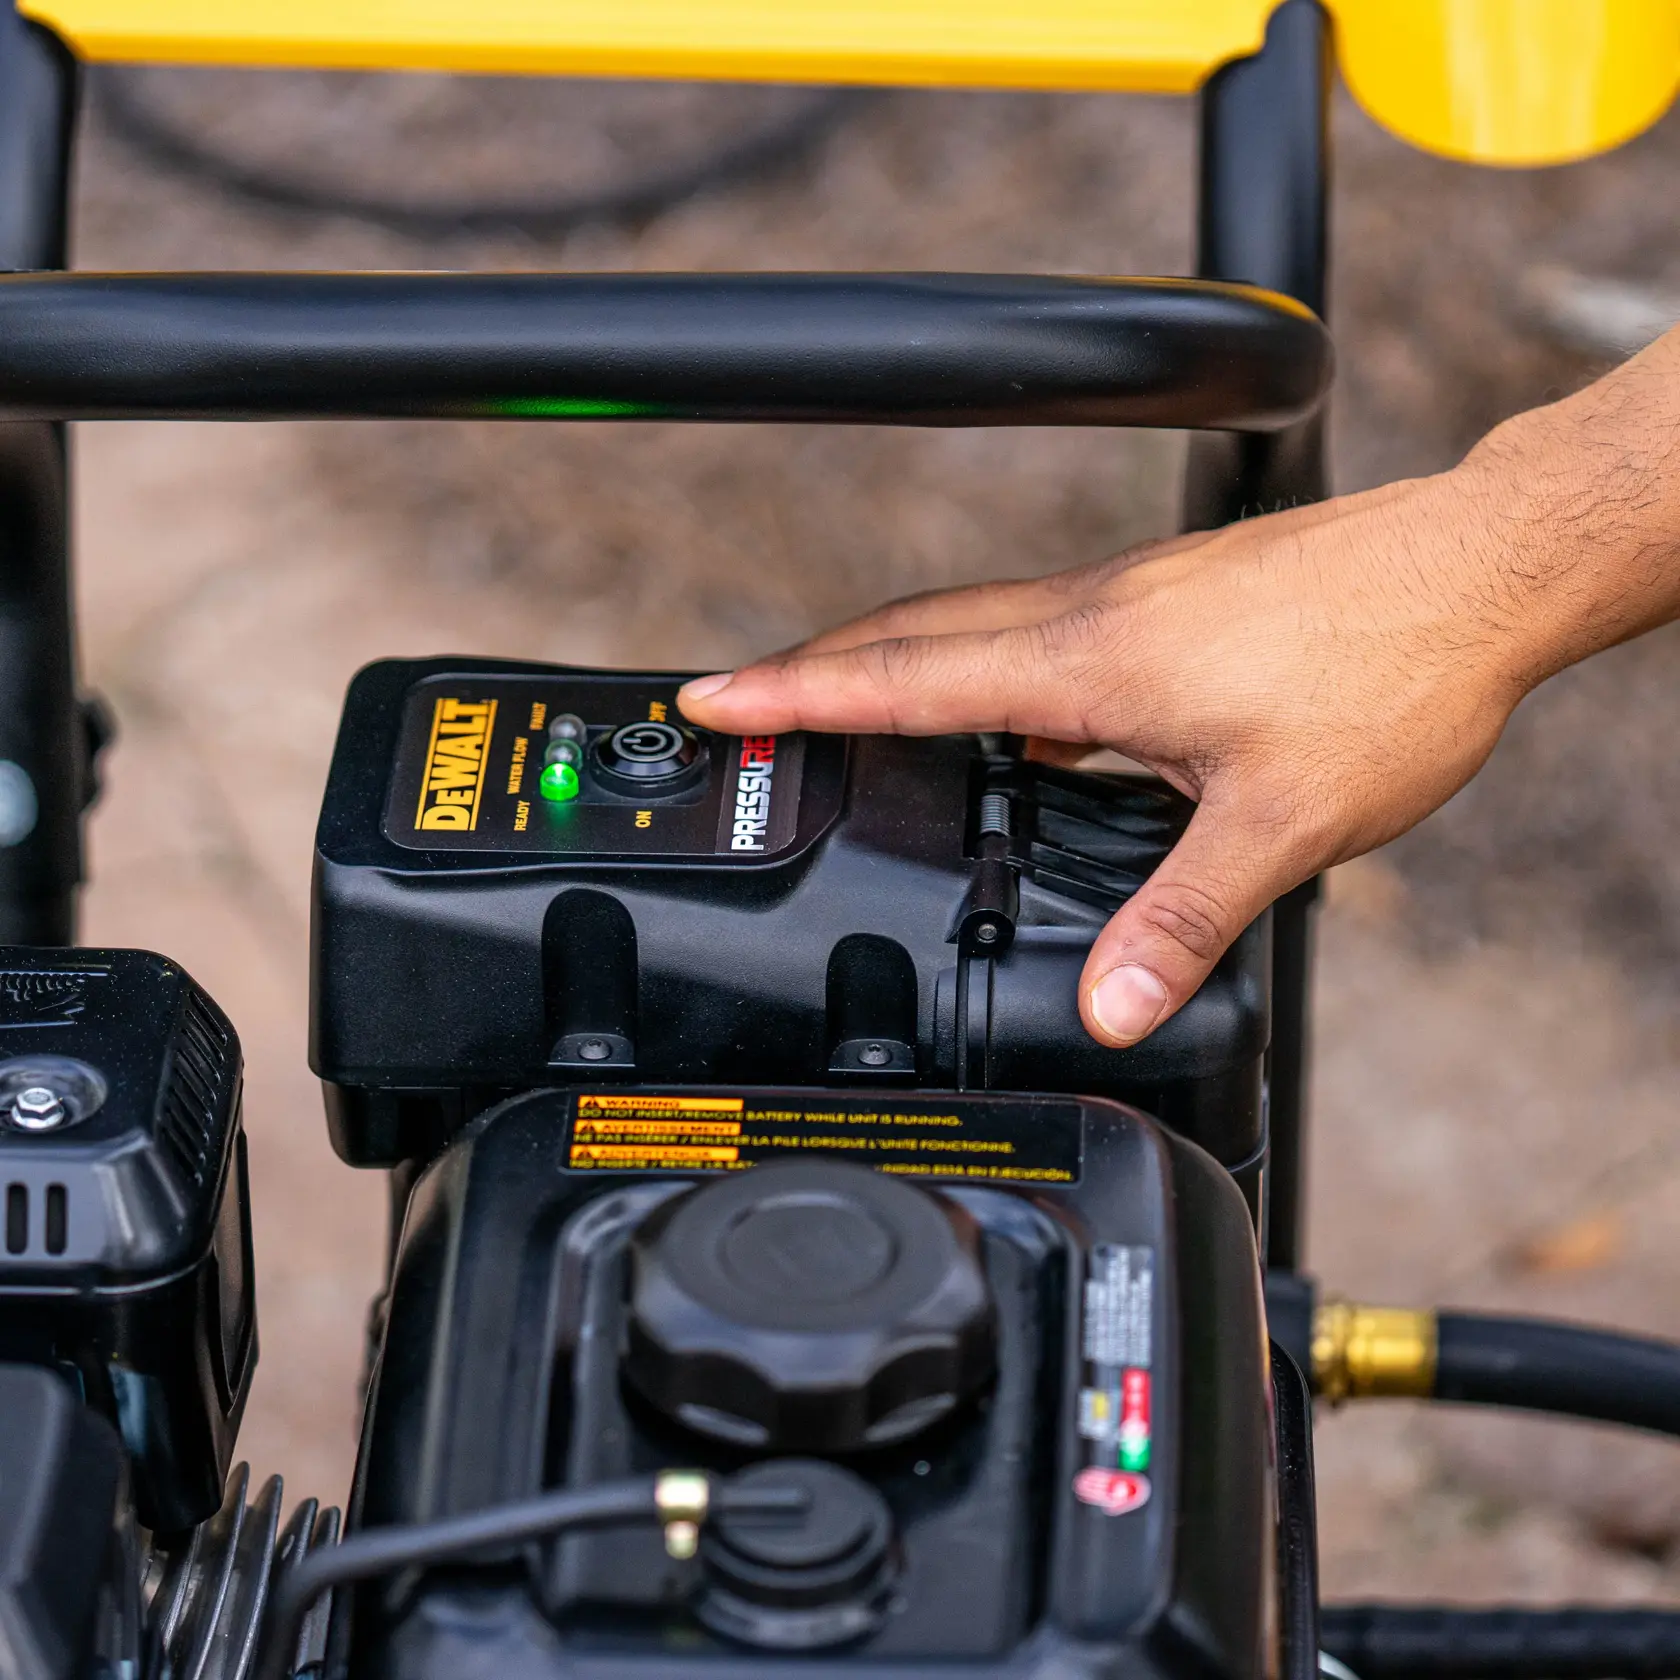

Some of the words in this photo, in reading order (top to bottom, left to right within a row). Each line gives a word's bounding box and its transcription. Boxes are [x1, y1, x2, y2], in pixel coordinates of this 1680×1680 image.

[529, 702, 547, 731] FAULT
[648, 701, 668, 722] OFF
[512, 736, 529, 762] FLOW
[507, 763, 525, 794] WATER
[514, 800, 530, 831] READY
[635, 811, 652, 828] ON
[606, 1100, 680, 1109] WARNING
[578, 1109, 602, 1118] DO
[604, 1109, 634, 1119] NOT
[745, 1110, 801, 1121] BATTERY
[804, 1112, 846, 1123] WHILE
[848, 1113, 878, 1123] UNIT
[880, 1114, 892, 1124] IS
[894, 1114, 963, 1127] RUNNING.
[574, 1134, 593, 1143] NE
[595, 1134, 621, 1143] PAS
[690, 1135, 750, 1146] ENLEVER
[751, 1135, 770, 1146] LA
[772, 1136, 800, 1147] PILE
[801, 1136, 866, 1149] LORSQUE
[966, 1165, 987, 1177] EN
